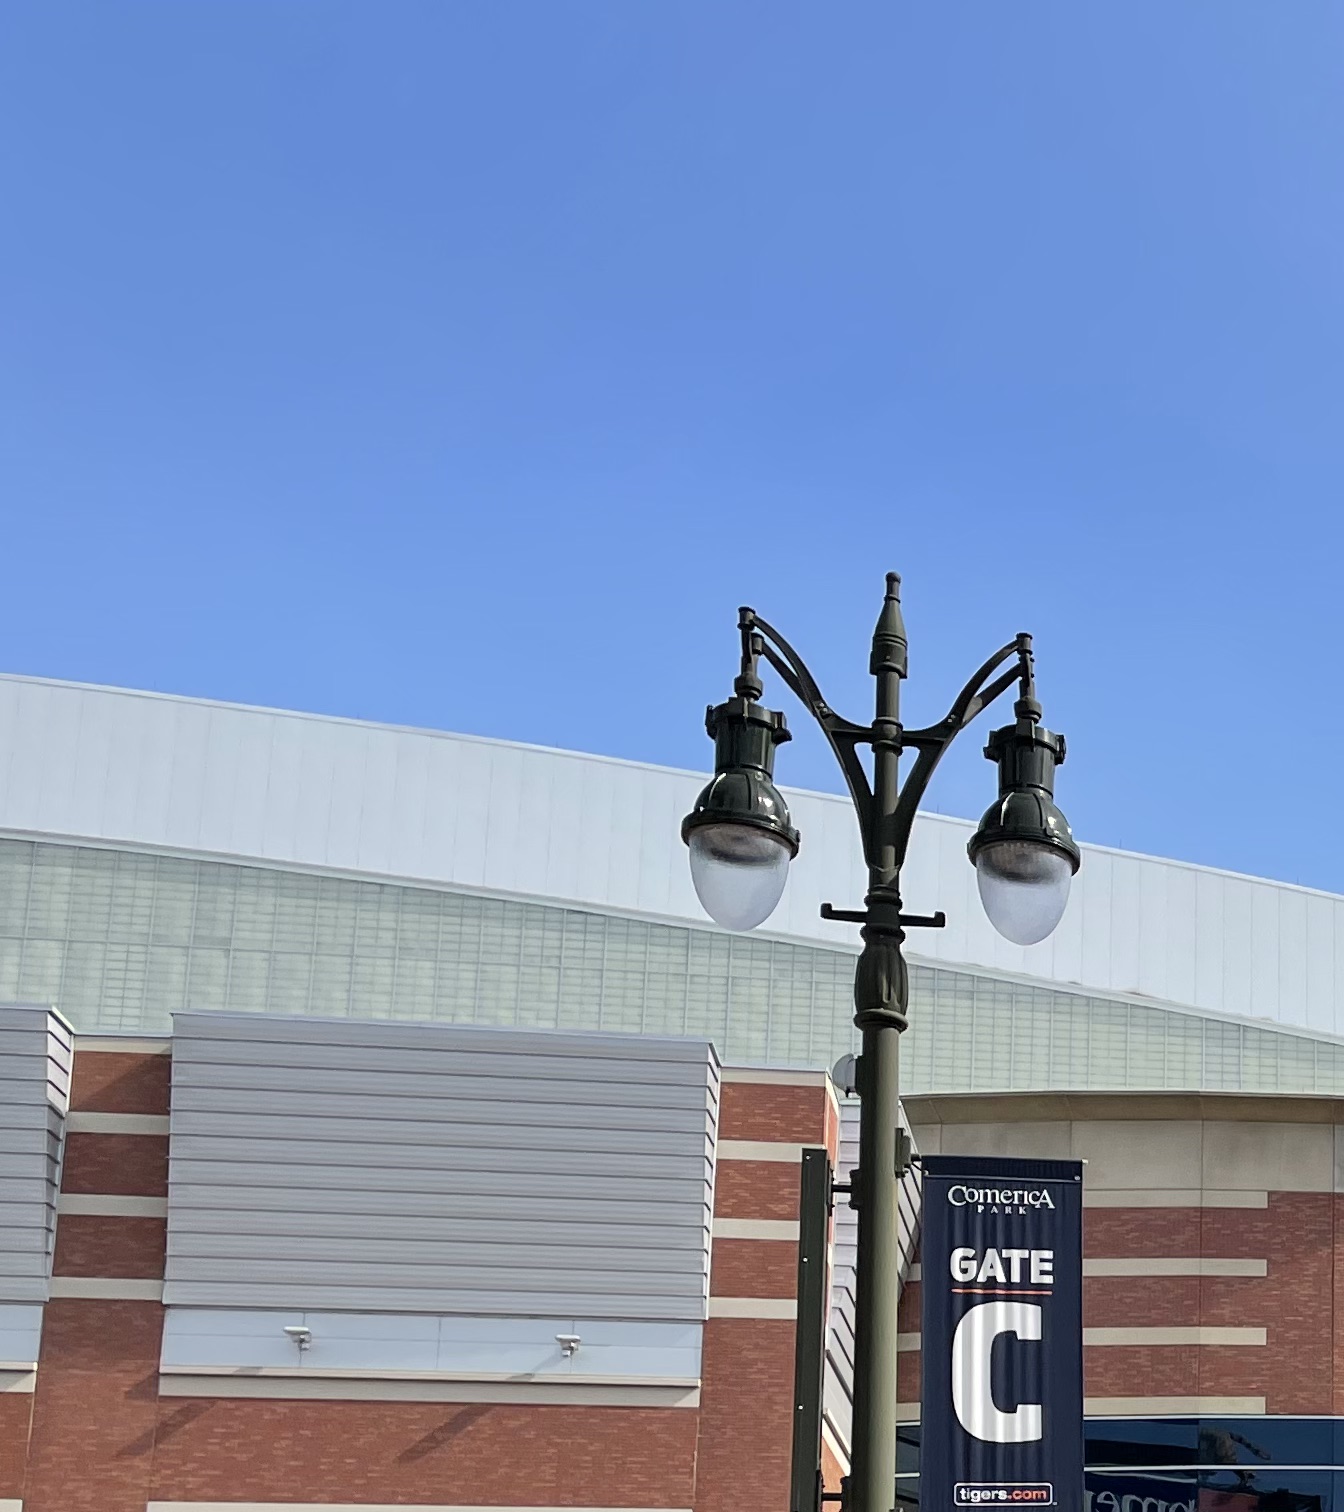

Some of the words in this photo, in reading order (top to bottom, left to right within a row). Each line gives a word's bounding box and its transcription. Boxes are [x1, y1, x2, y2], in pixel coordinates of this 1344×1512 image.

[977, 1205, 1027, 1215] PARK
[950, 1247, 1054, 1284] GATE
[952, 1301, 1042, 1443] C
[959, 1487, 1047, 1502] tigers.com
